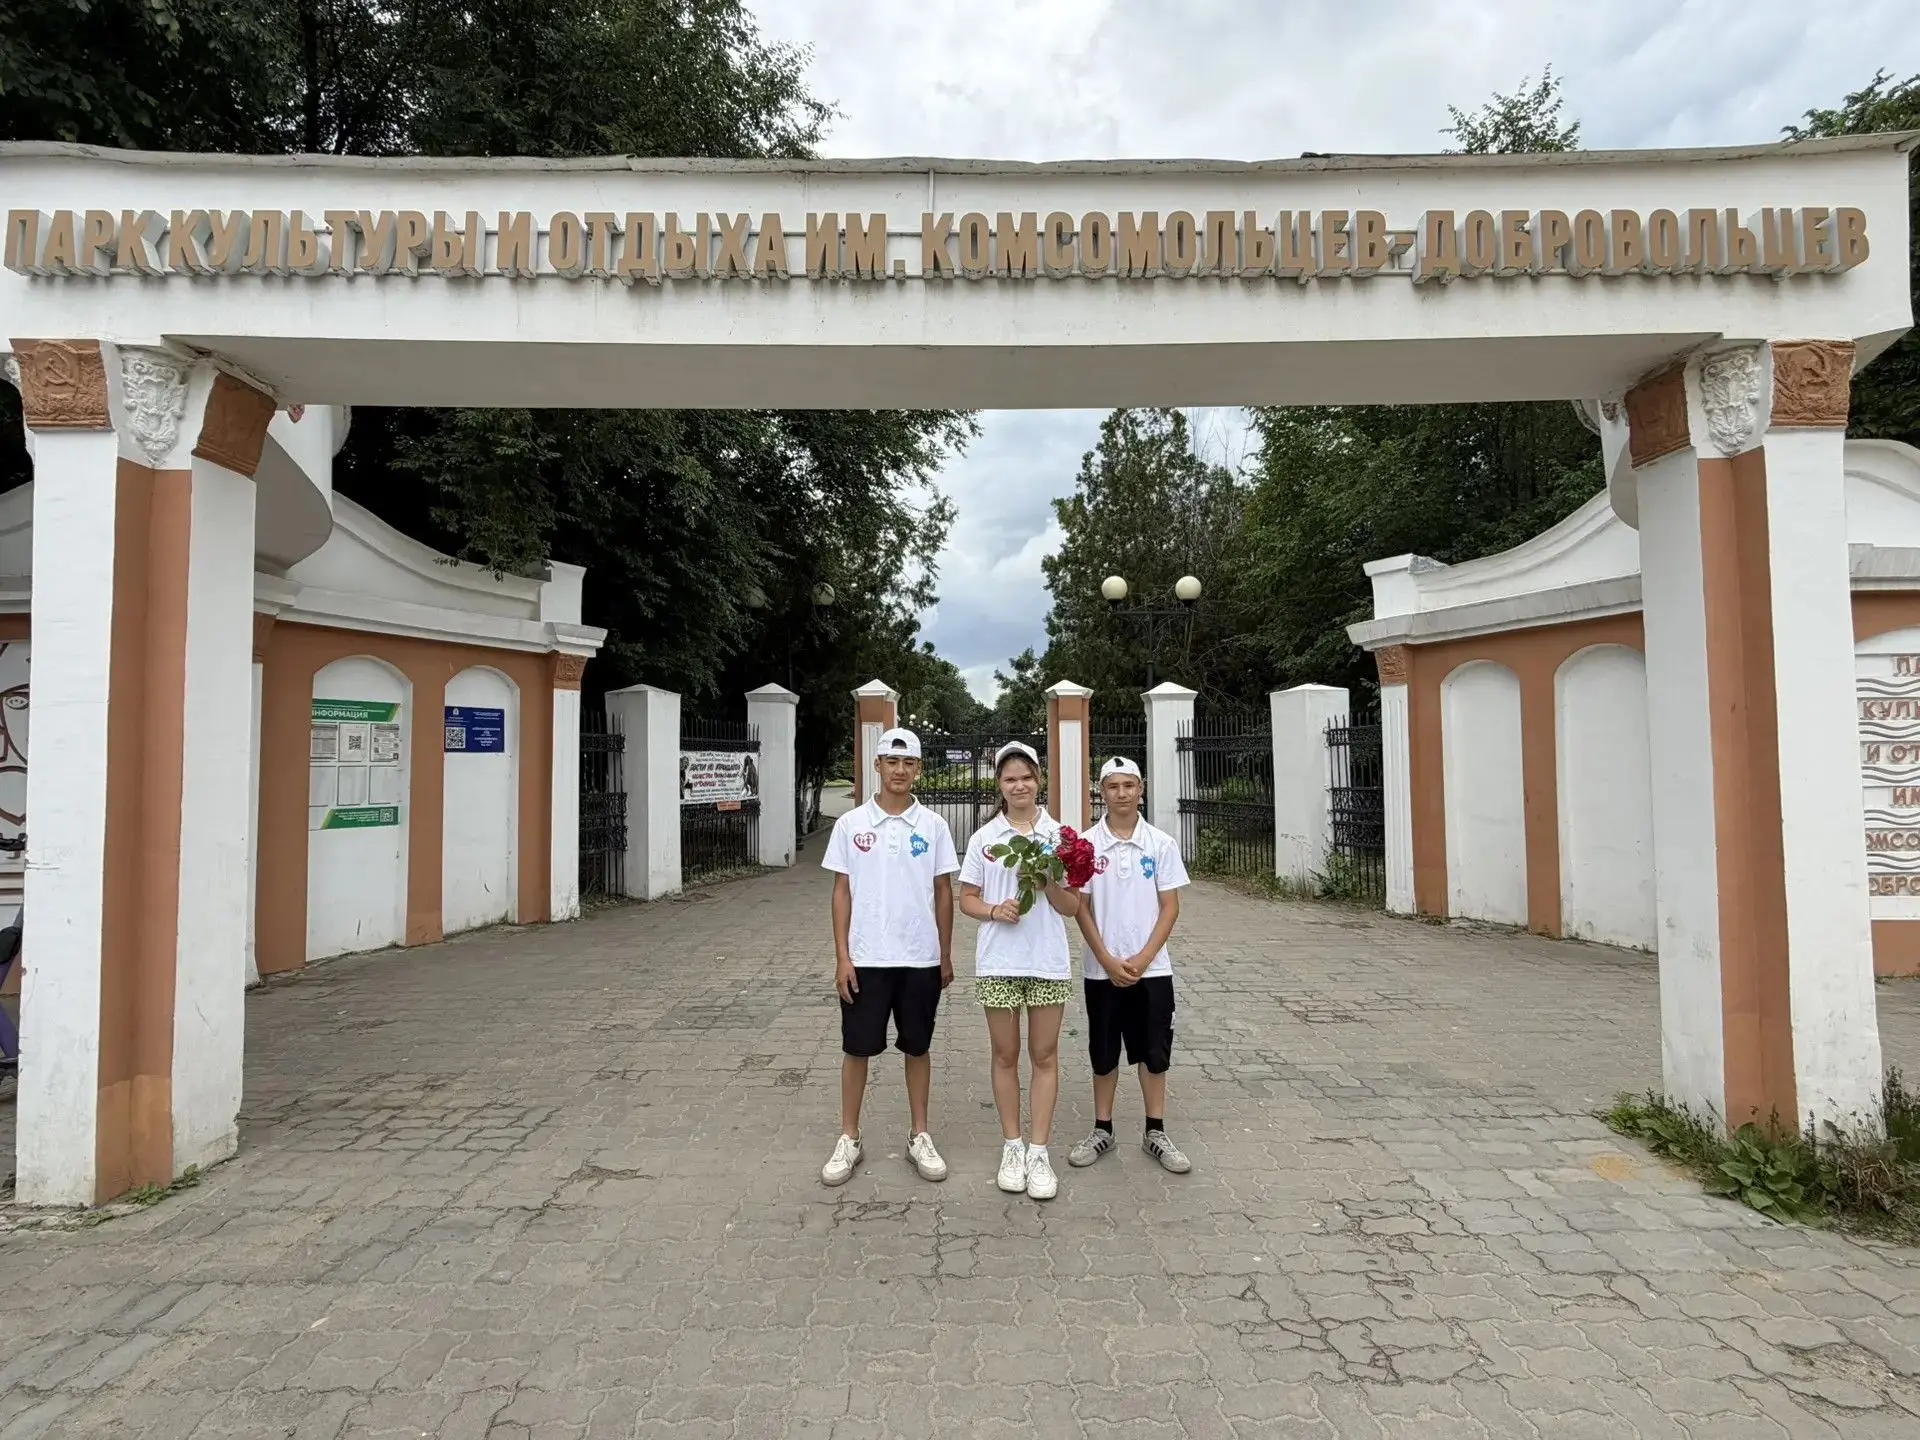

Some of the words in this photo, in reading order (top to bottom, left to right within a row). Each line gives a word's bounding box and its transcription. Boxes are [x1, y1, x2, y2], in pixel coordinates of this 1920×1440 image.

[4, 208, 164, 276] ПАРК
[168, 209, 485, 277] КУЛЬТУРЫ
[497, 210, 537, 278] И
[548, 211, 789, 287] ОТДЫХА
[805, 211, 906, 280] ИМ.
[921, 207, 1870, 284] КОМСОМОЛЬЦЕВ-ДОБРОВОЛЬЦЕВ
